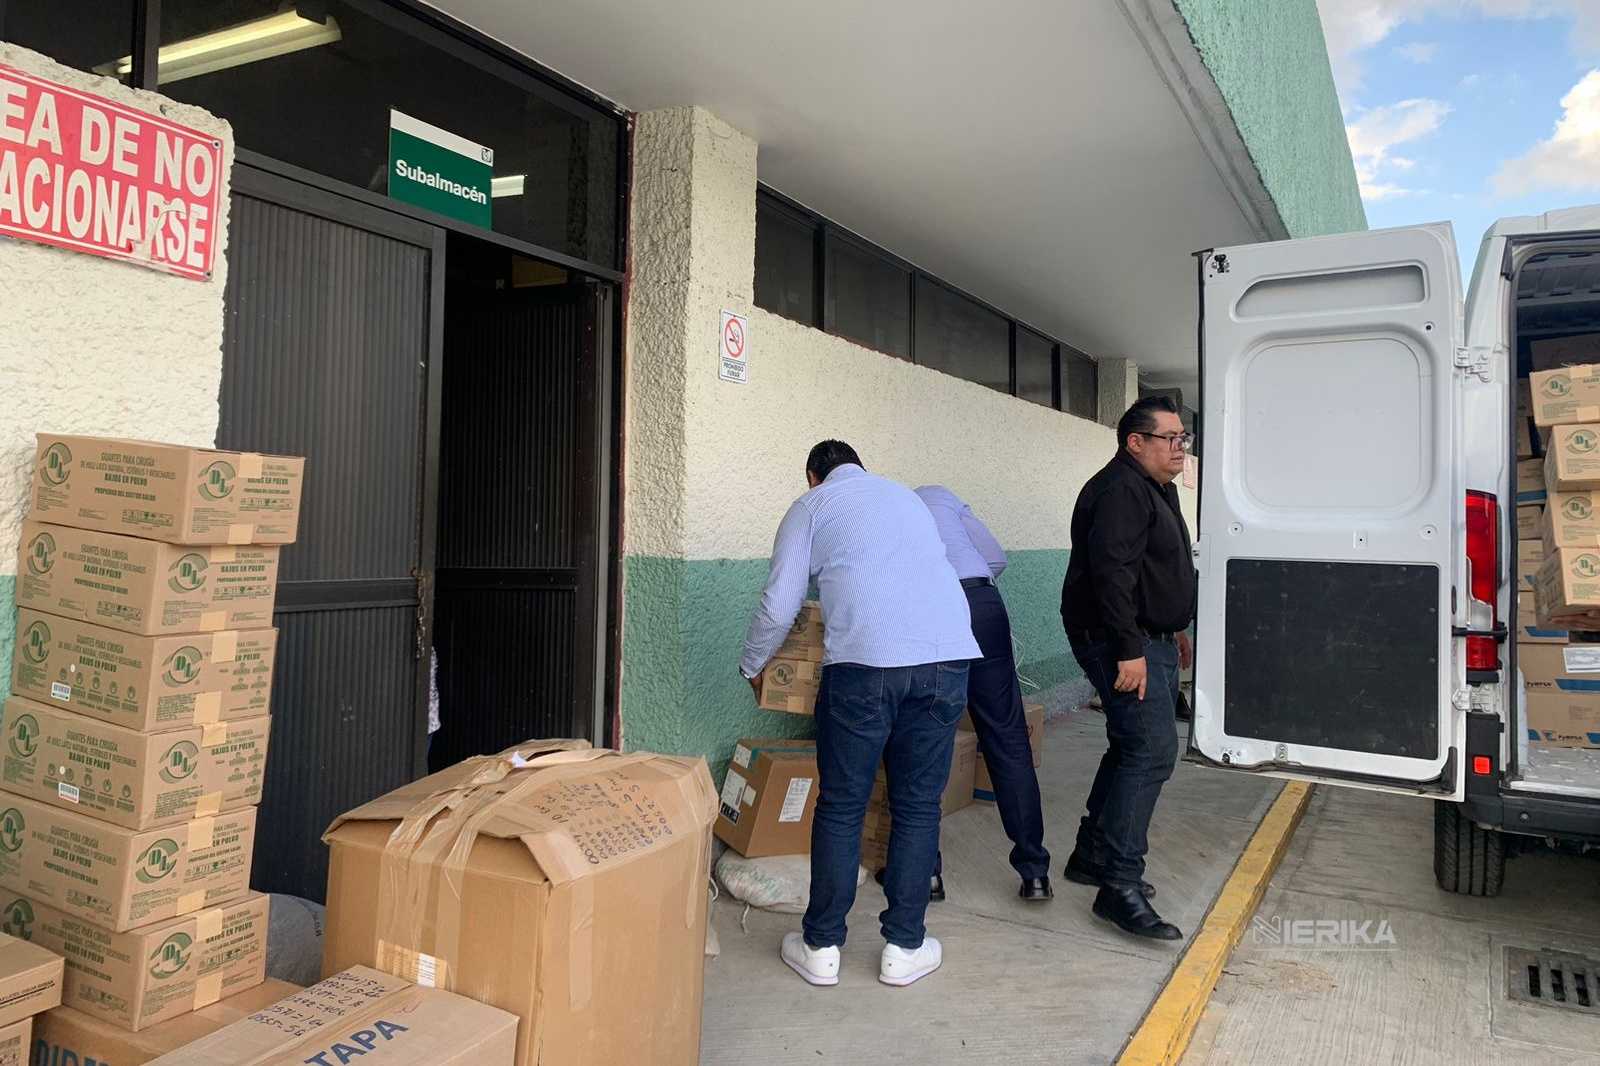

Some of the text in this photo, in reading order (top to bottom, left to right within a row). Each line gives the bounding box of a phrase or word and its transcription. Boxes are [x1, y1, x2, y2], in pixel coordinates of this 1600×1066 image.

[80, 106, 141, 177] DE
[154, 132, 213, 198] NO
[396, 159, 487, 204] Subalmacén
[0, 151, 208, 268] ACIONARSE
[303, 1020, 408, 1066] TAPA
